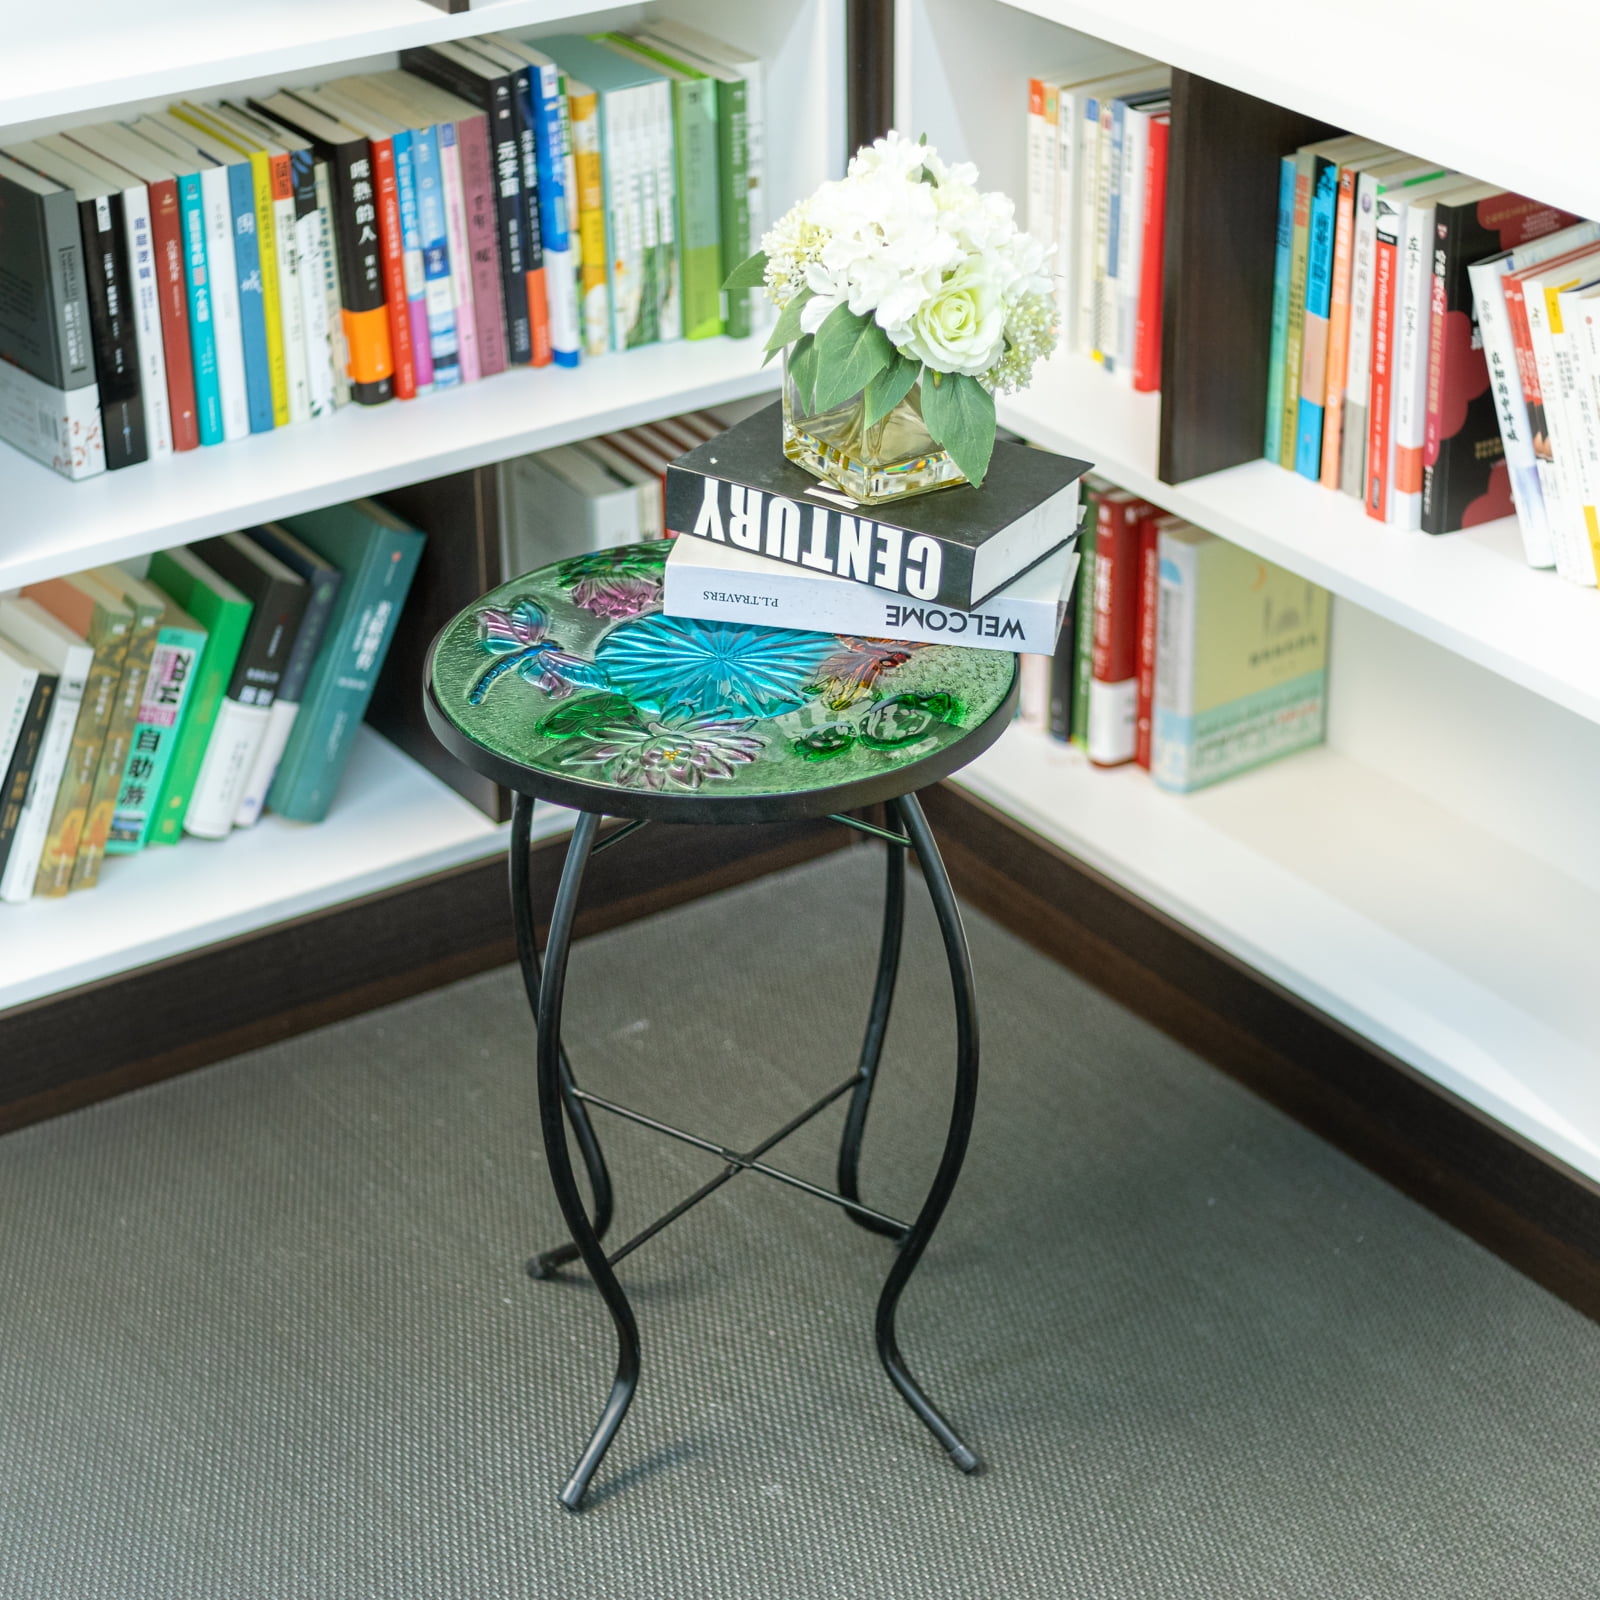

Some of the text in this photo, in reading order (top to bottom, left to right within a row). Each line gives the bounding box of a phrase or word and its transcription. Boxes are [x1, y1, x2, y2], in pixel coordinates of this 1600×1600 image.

[497, 140, 519, 198] 元宇宙
[350, 158, 377, 245] 晚熟的人
[134, 216, 151, 280] 底层逻辑
[693, 477, 943, 602] CENTURY
[885, 604, 1026, 640] WELCOME
[160, 652, 191, 704] 2014
[120, 728, 161, 807] 自助游
